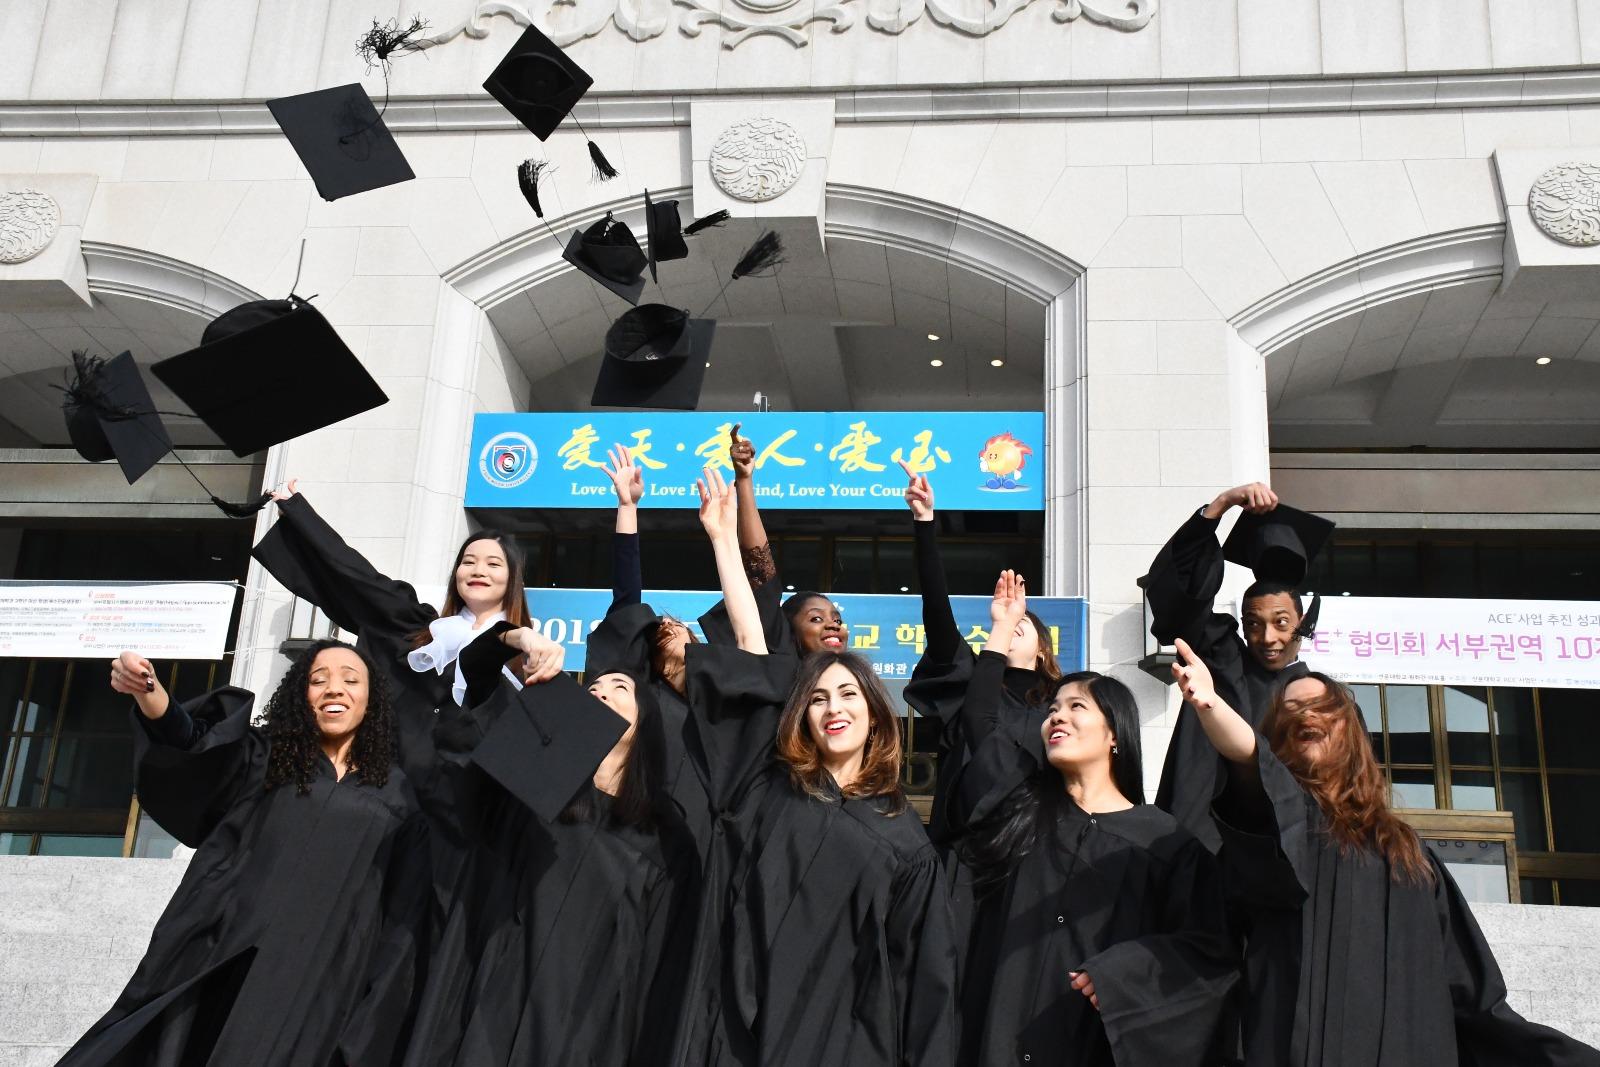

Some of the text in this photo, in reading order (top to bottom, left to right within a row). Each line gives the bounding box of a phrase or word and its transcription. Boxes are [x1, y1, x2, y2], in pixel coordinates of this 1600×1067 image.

[571, 482, 607, 496] Love
[650, 483, 686, 496] Love
[788, 483, 826, 497] Love
[829, 483, 867, 497] Your
[1547, 613, 1573, 627] 추진
[1348, 630, 1426, 658] 협의회
[1435, 632, 1544, 662] 서부권역
